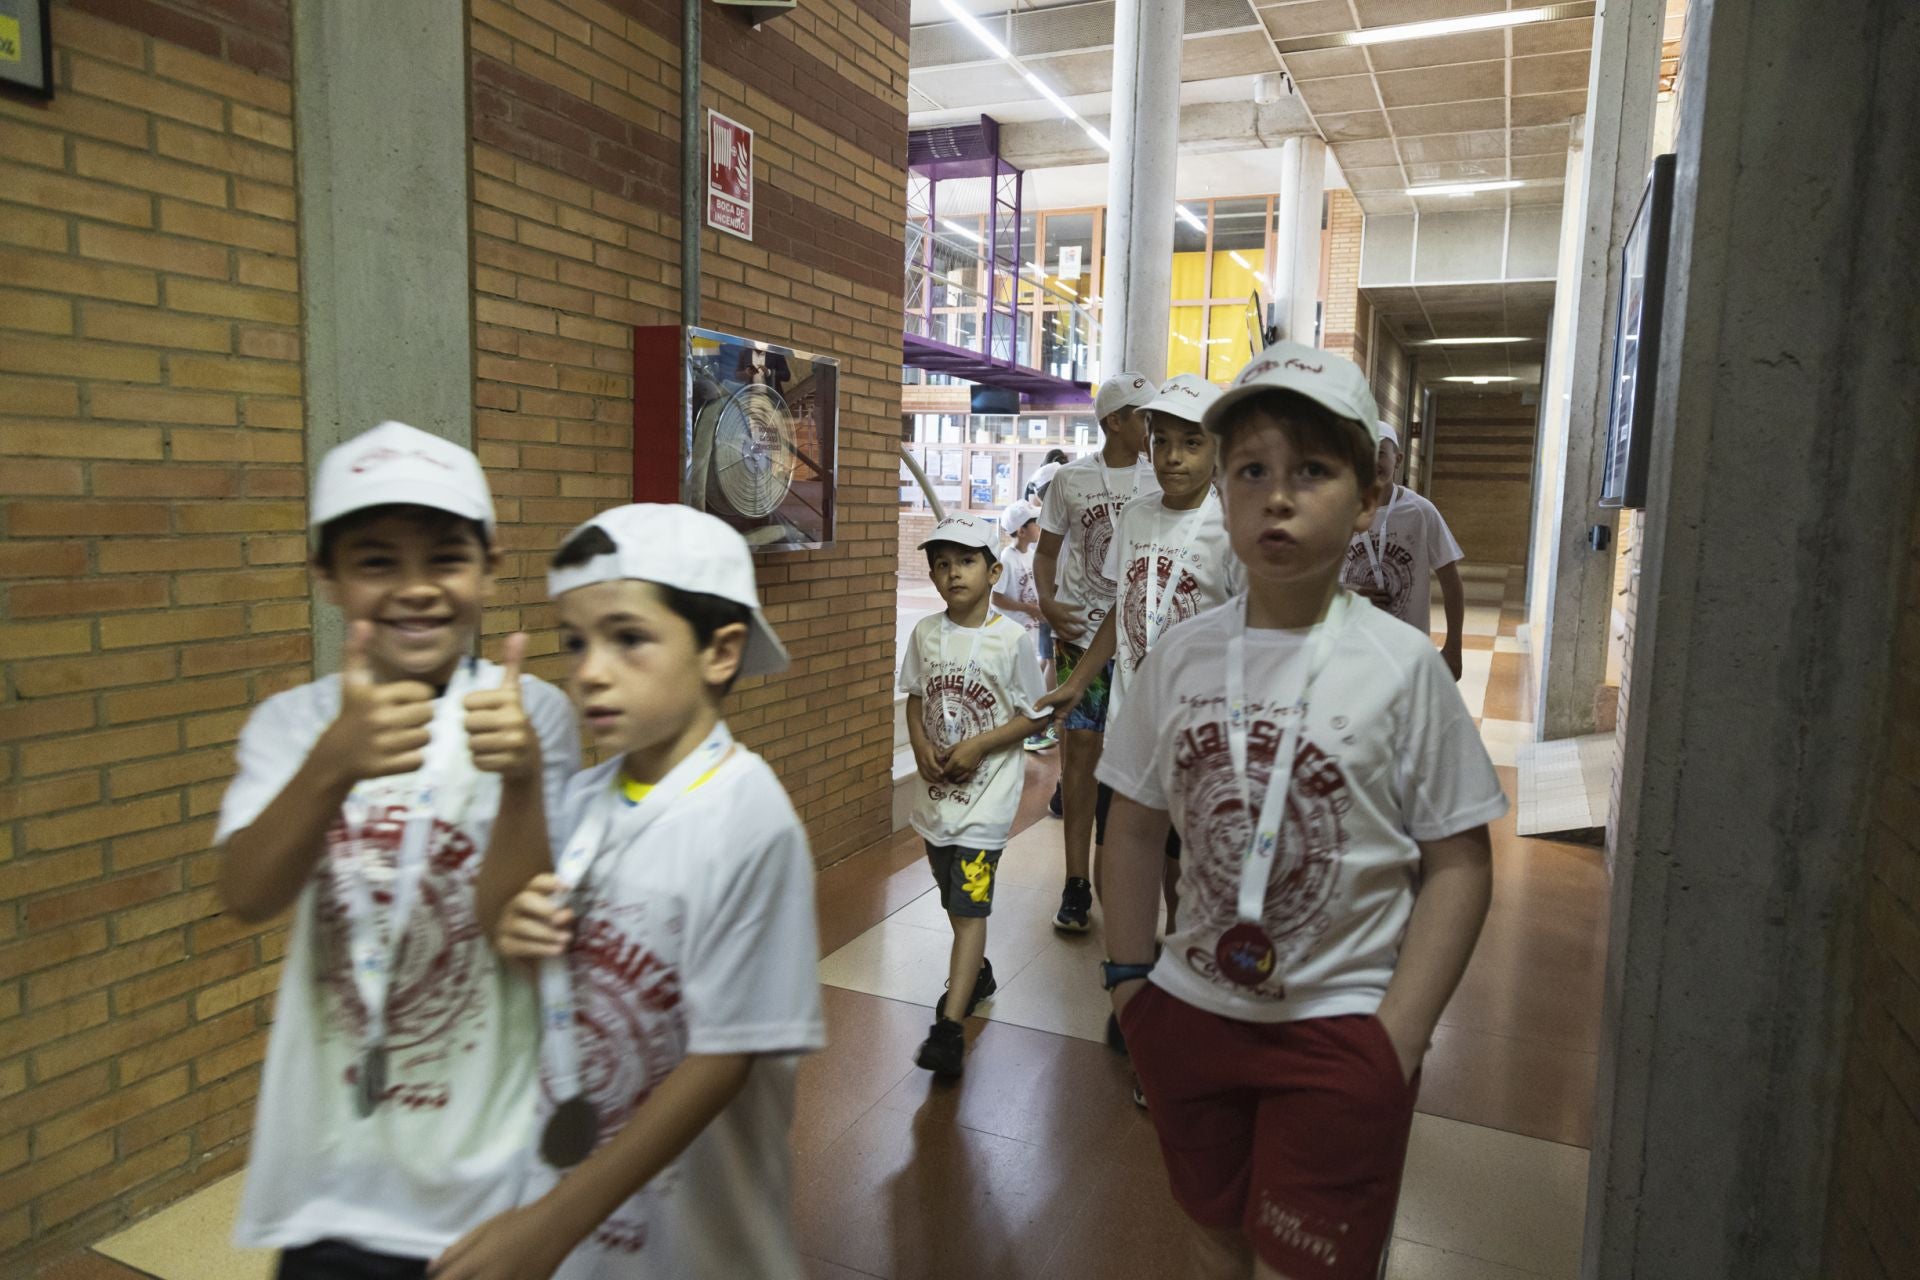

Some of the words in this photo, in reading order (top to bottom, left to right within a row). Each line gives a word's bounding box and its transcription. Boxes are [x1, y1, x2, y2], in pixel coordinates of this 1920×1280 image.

[716, 199, 735, 214] BOCA
[736, 207, 745, 218] DE
[714, 211, 746, 231] INCENDIO
